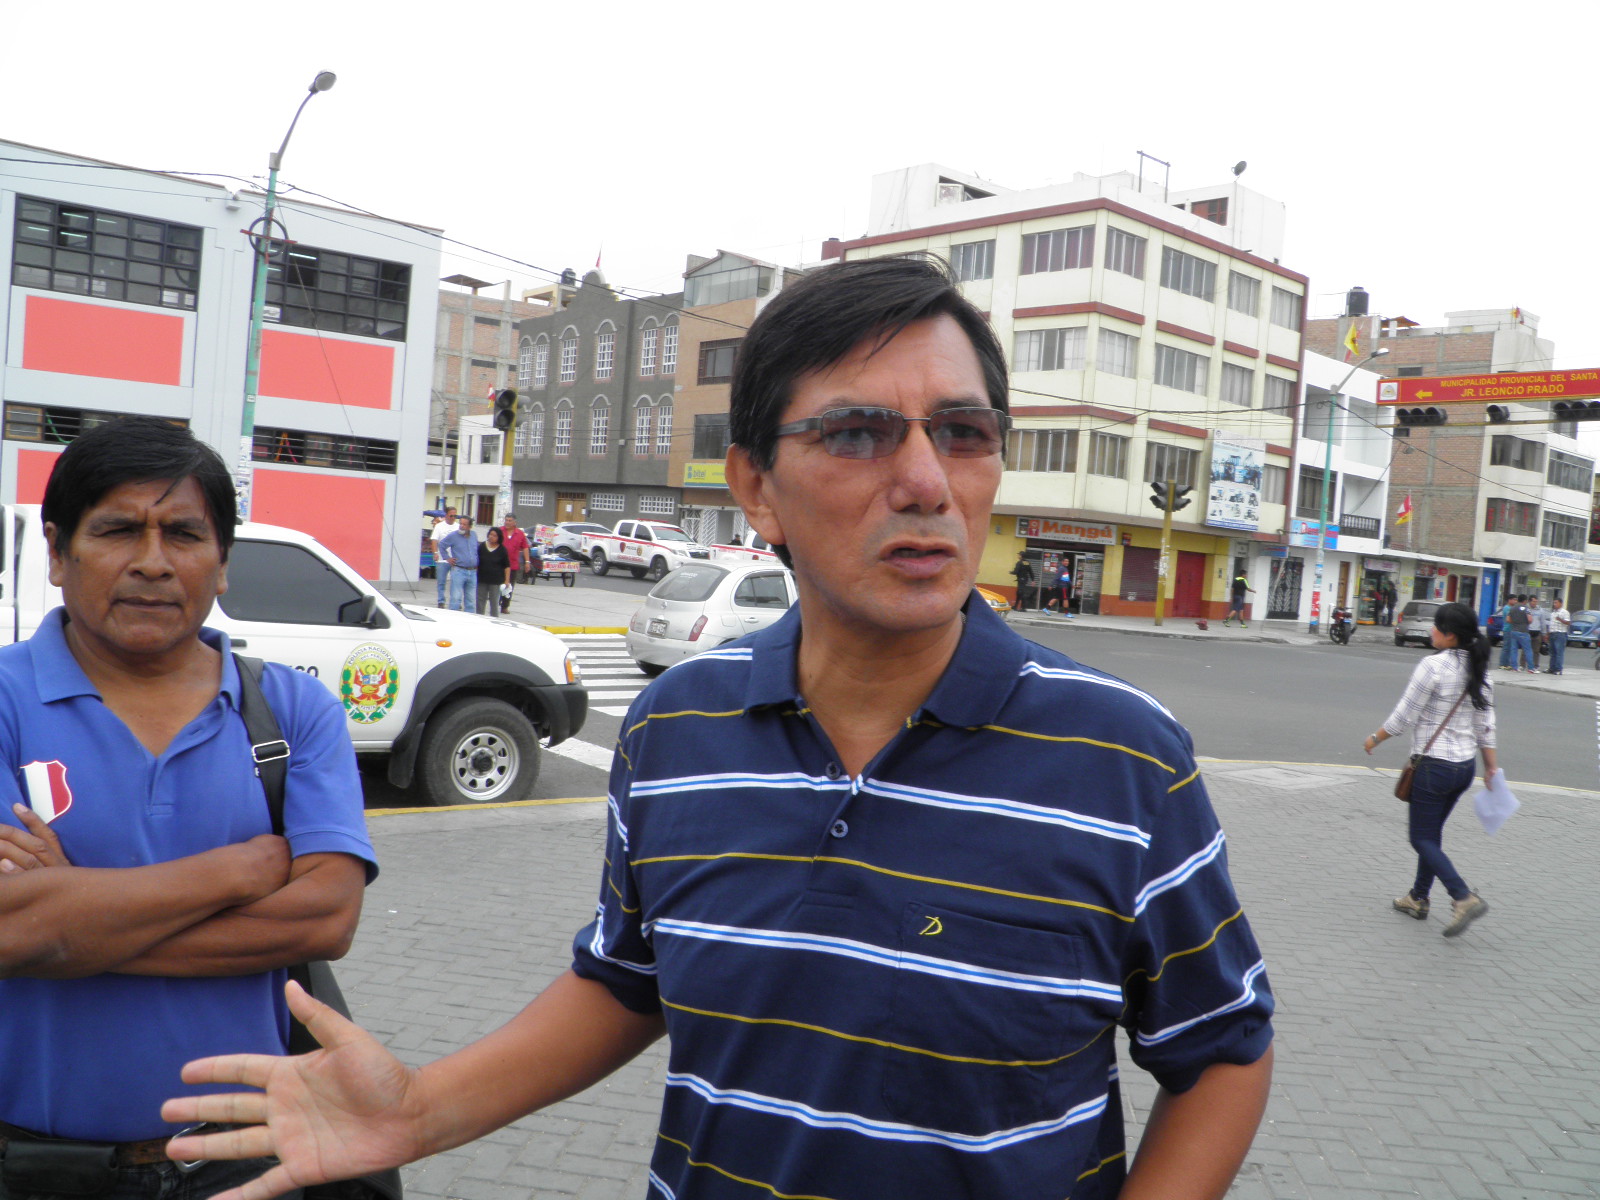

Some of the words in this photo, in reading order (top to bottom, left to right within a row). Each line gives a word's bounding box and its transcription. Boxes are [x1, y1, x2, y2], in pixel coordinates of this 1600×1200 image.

[1440, 378, 1498, 388] MUNICIPALIDAD
[1500, 375, 1547, 385] PROVINCIAL
[1550, 374, 1567, 382] DEL
[1570, 372, 1599, 381] SANTA
[1460, 389, 1476, 398] JR.
[1479, 386, 1525, 397] LEONCIO
[1527, 384, 1565, 394] PRADO
